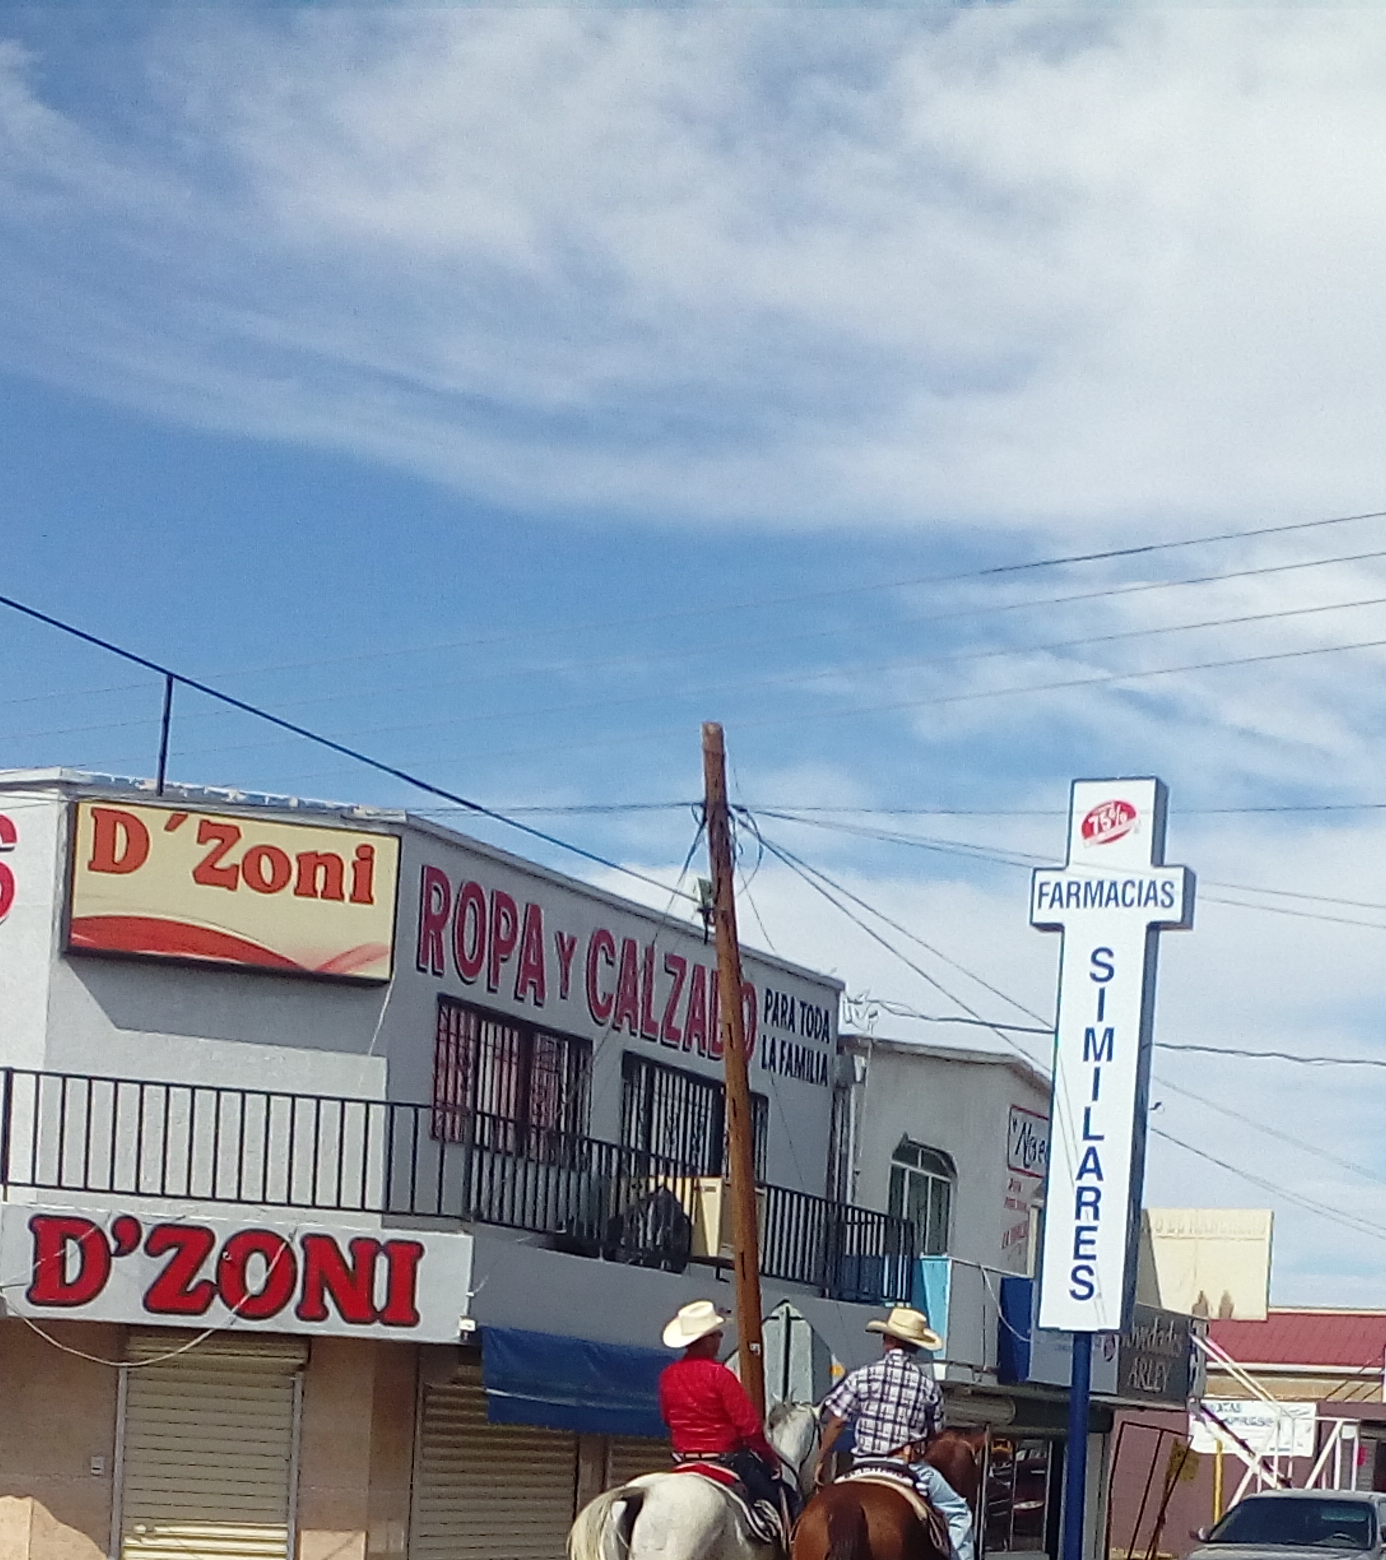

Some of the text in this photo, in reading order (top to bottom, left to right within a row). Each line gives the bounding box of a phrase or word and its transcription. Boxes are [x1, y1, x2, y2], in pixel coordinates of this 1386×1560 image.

[1037, 879, 1175, 910] FARMACIAS
[416, 864, 547, 1008] ROPA
[554, 931, 577, 999] Y
[763, 987, 830, 1045] PARA TODA
[761, 1034, 828, 1088] LA FAMILIA
[1069, 946, 1115, 1301] SIMILARES
